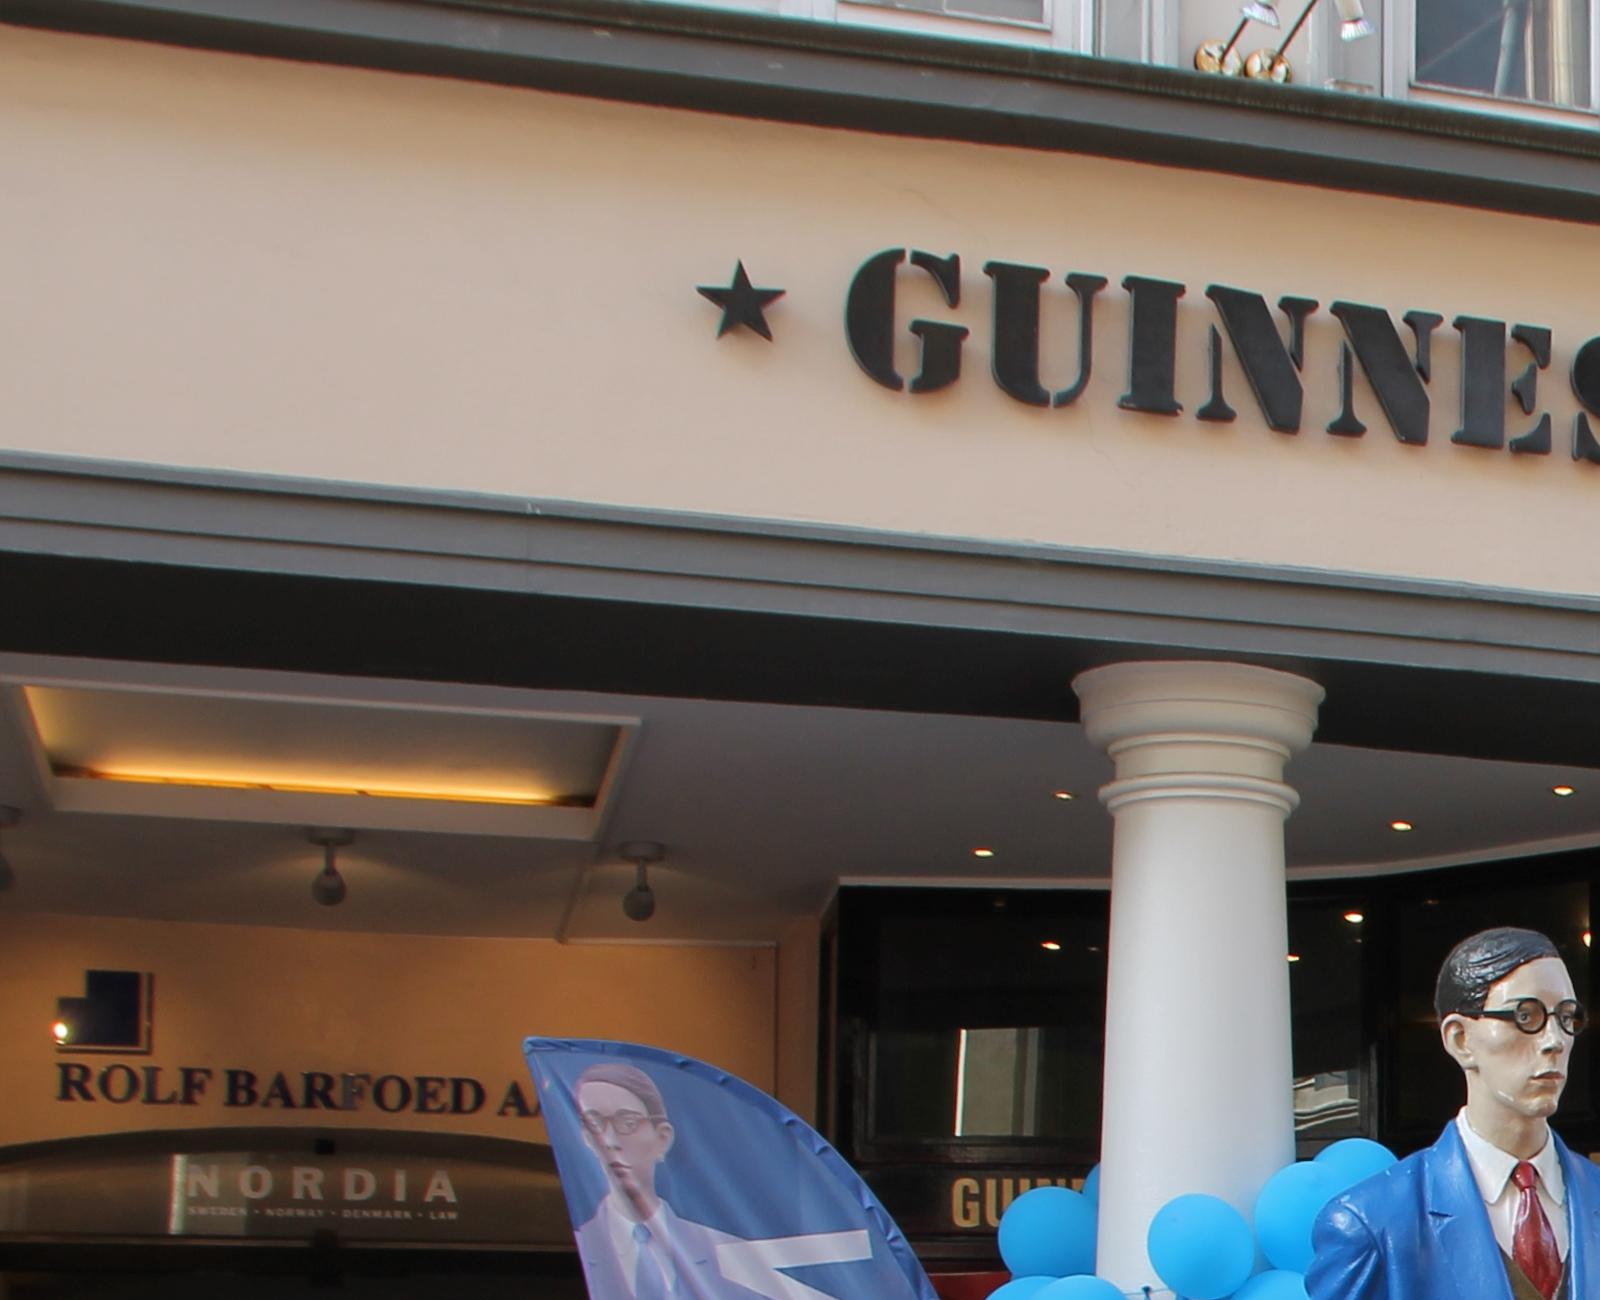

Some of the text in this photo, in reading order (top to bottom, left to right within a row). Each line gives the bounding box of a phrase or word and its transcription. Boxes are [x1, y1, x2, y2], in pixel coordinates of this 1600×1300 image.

[56, 1062, 213, 1106] ROLF
[225, 1069, 486, 1116] BARFOED
[187, 1164, 458, 1203] NORDIA
[188, 1205, 458, 1221] SWEDEN NORWAY DENMARK LAW
